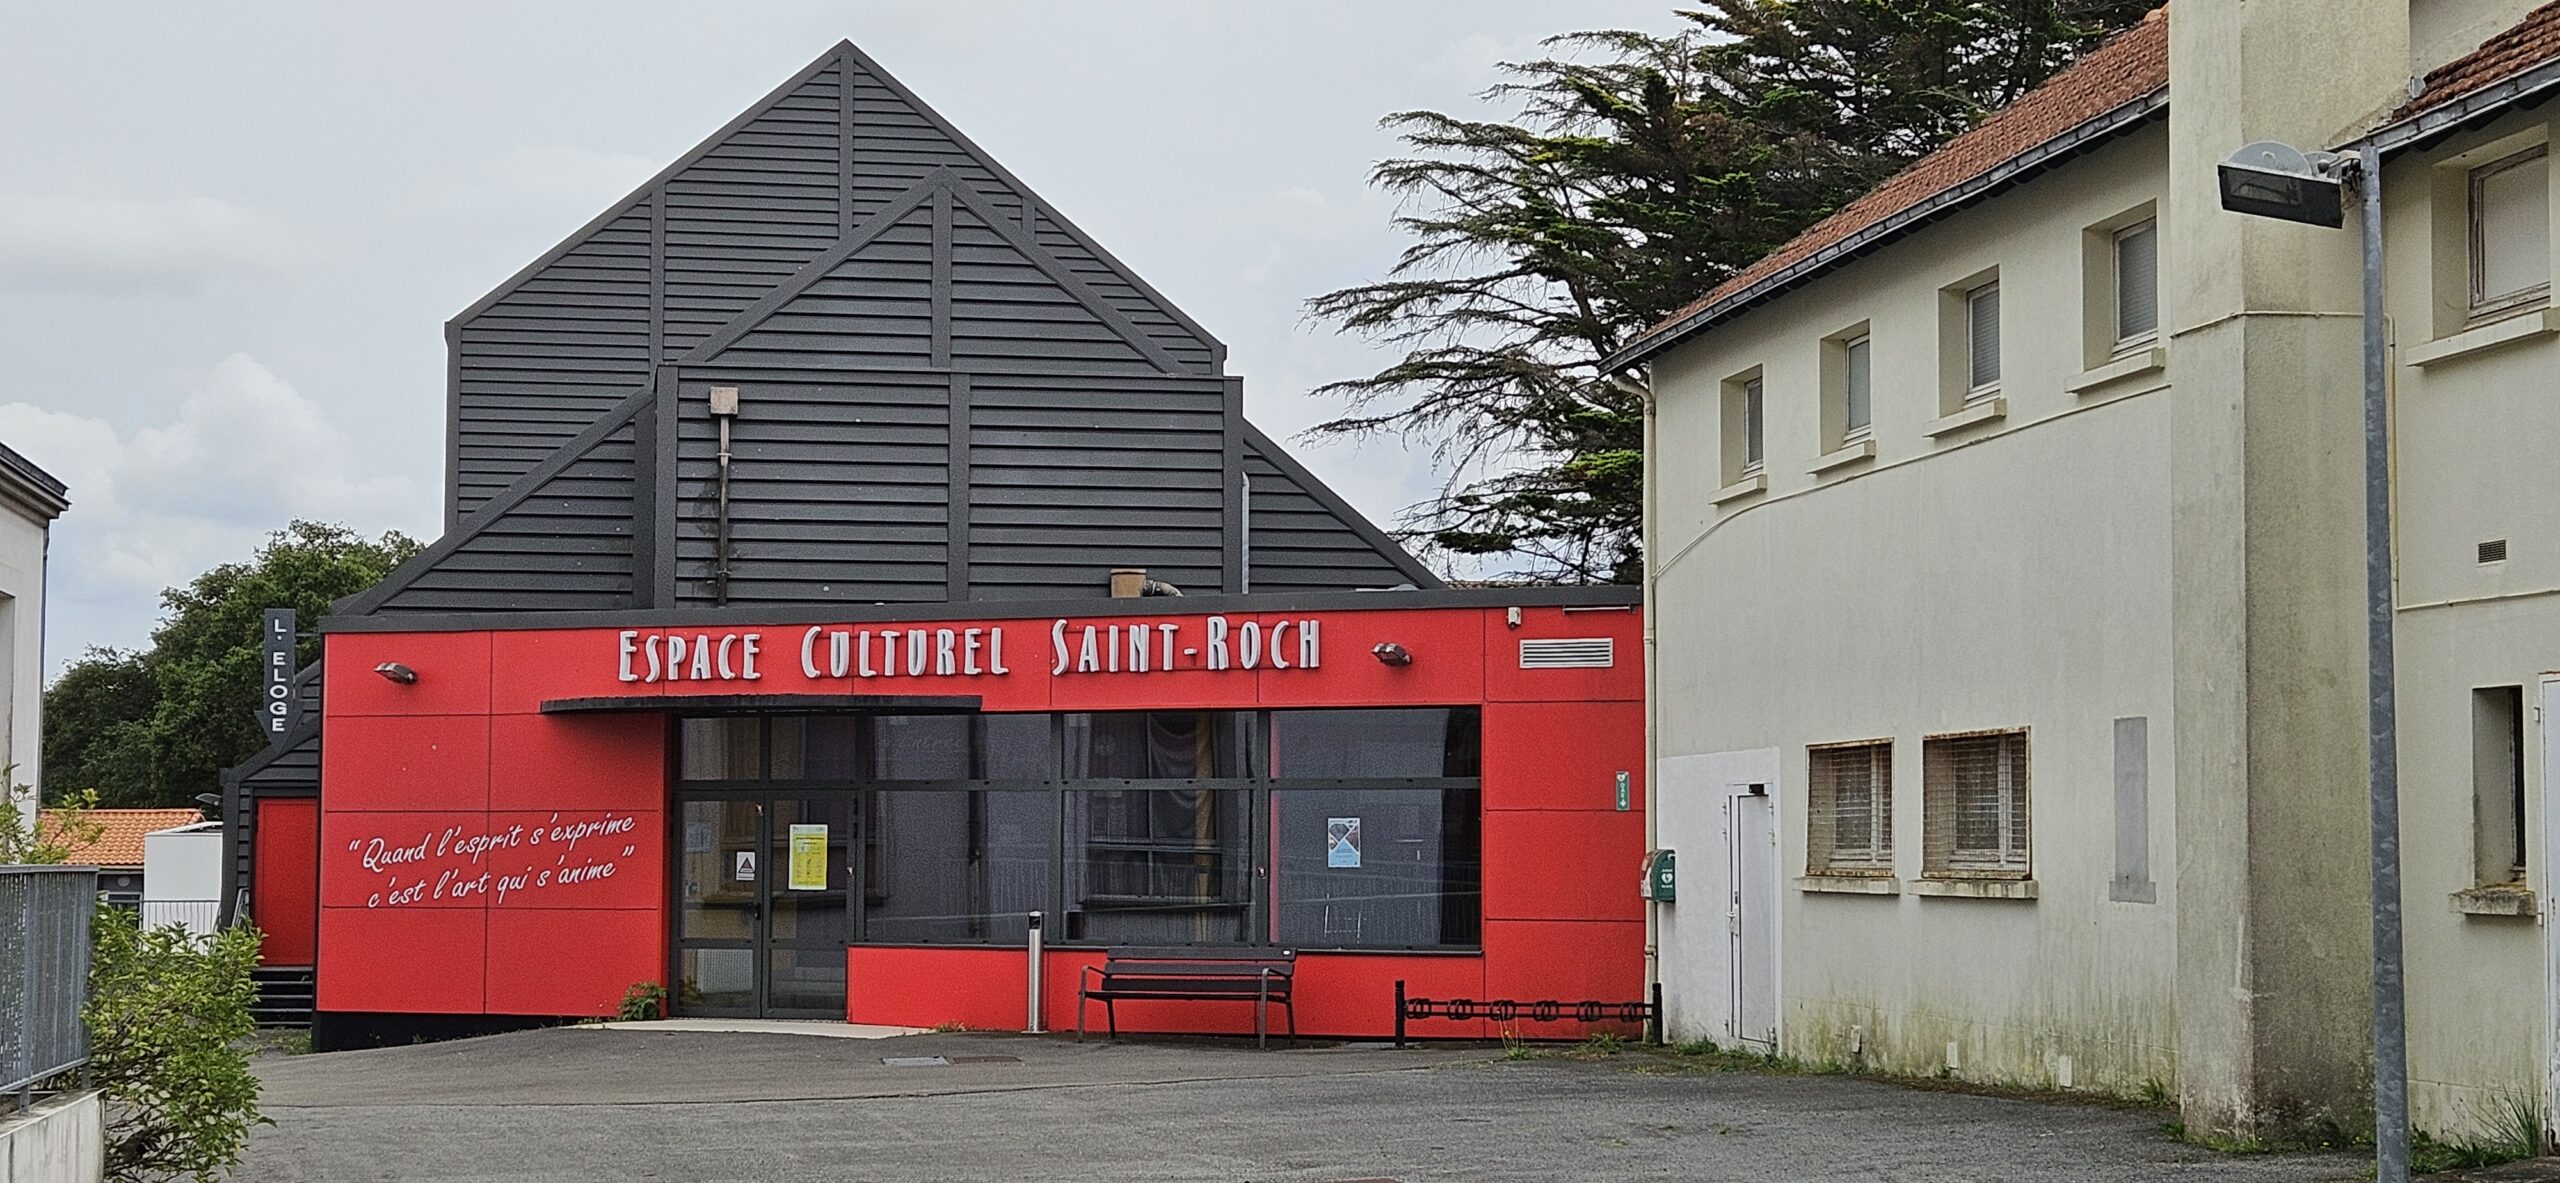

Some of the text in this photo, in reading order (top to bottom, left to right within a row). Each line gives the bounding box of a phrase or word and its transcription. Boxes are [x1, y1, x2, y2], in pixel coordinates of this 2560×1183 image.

[618, 615, 1321, 683] ESPACE CULTUREL SAINT-ROCH
[269, 651, 289, 732] ELOGE
[436, 824, 524, 864] l'esprit
[529, 812, 636, 850] s'exprime
[367, 876, 427, 908] c'est
[432, 868, 492, 900] l'art
[497, 866, 532, 904] qui
